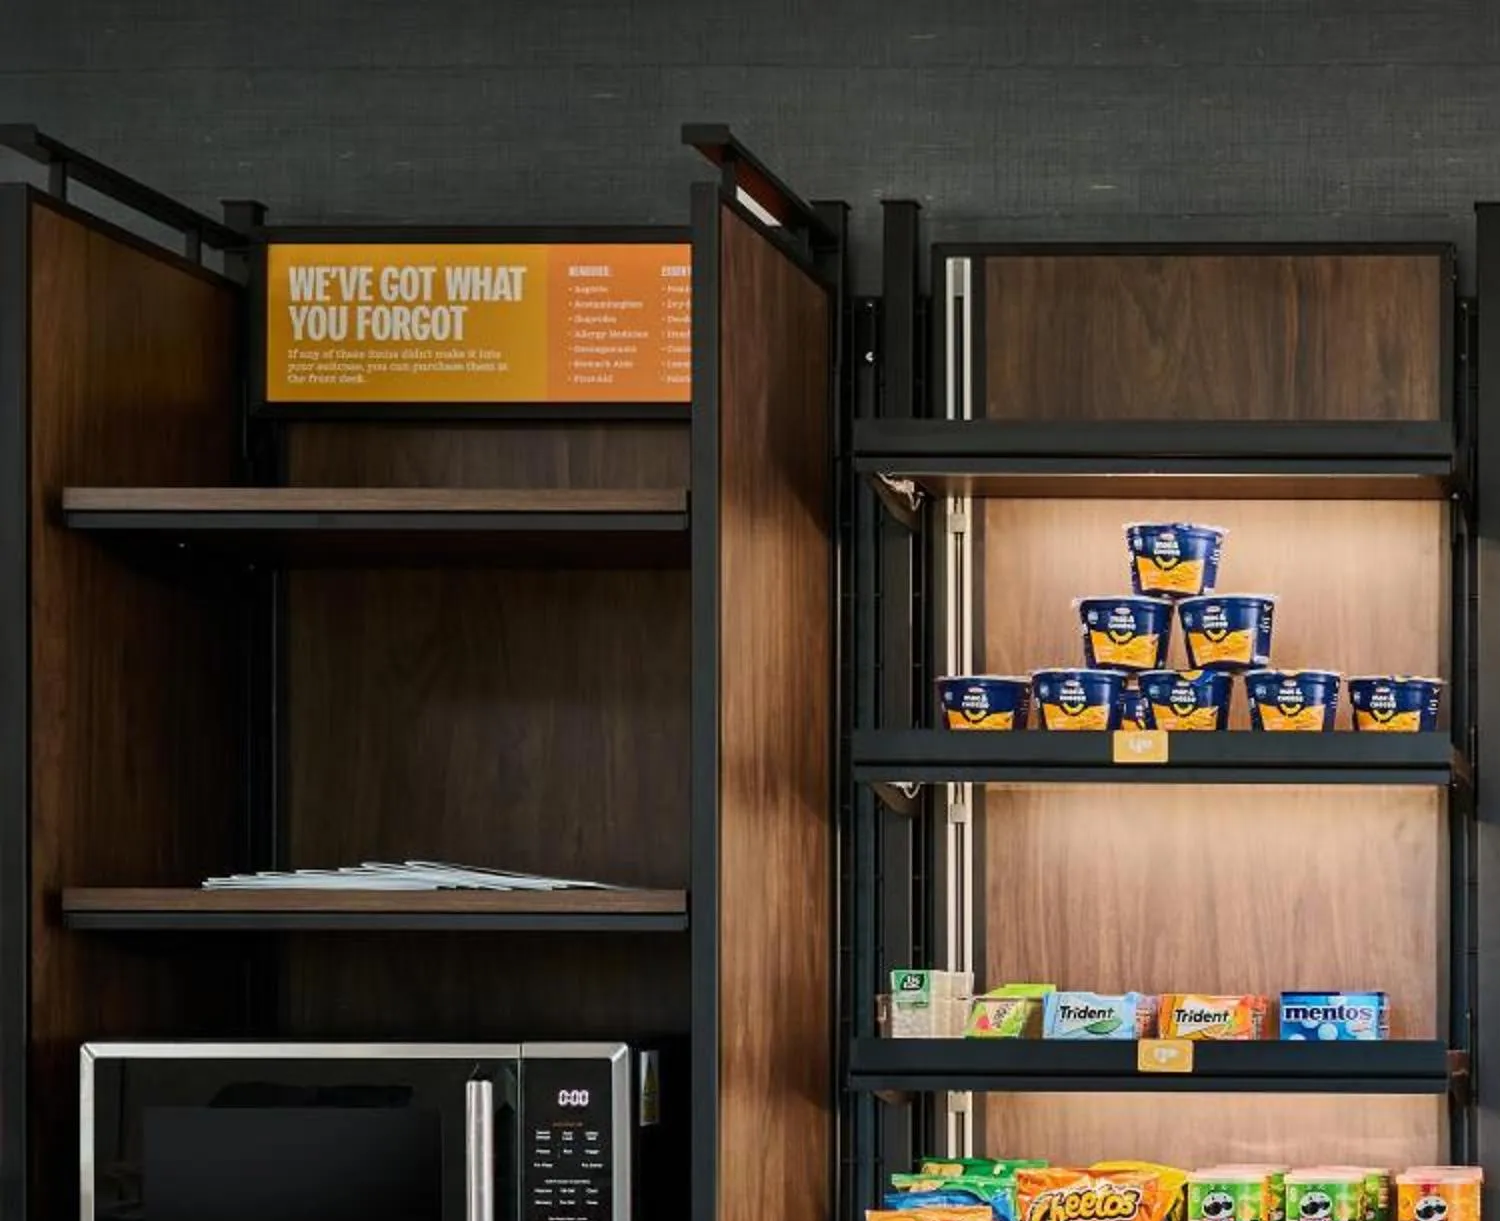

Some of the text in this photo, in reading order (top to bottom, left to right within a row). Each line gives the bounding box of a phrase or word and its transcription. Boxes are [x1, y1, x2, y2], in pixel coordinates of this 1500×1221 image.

[288, 266, 527, 302] WE'VE GOT WHAT
[288, 305, 468, 341] YOU FORGOT
[1060, 1005, 1115, 1020] Trident
[1174, 1008, 1230, 1023] Trident
[1285, 1005, 1374, 1021] mentos
[558, 1089, 589, 1106] 0:00
